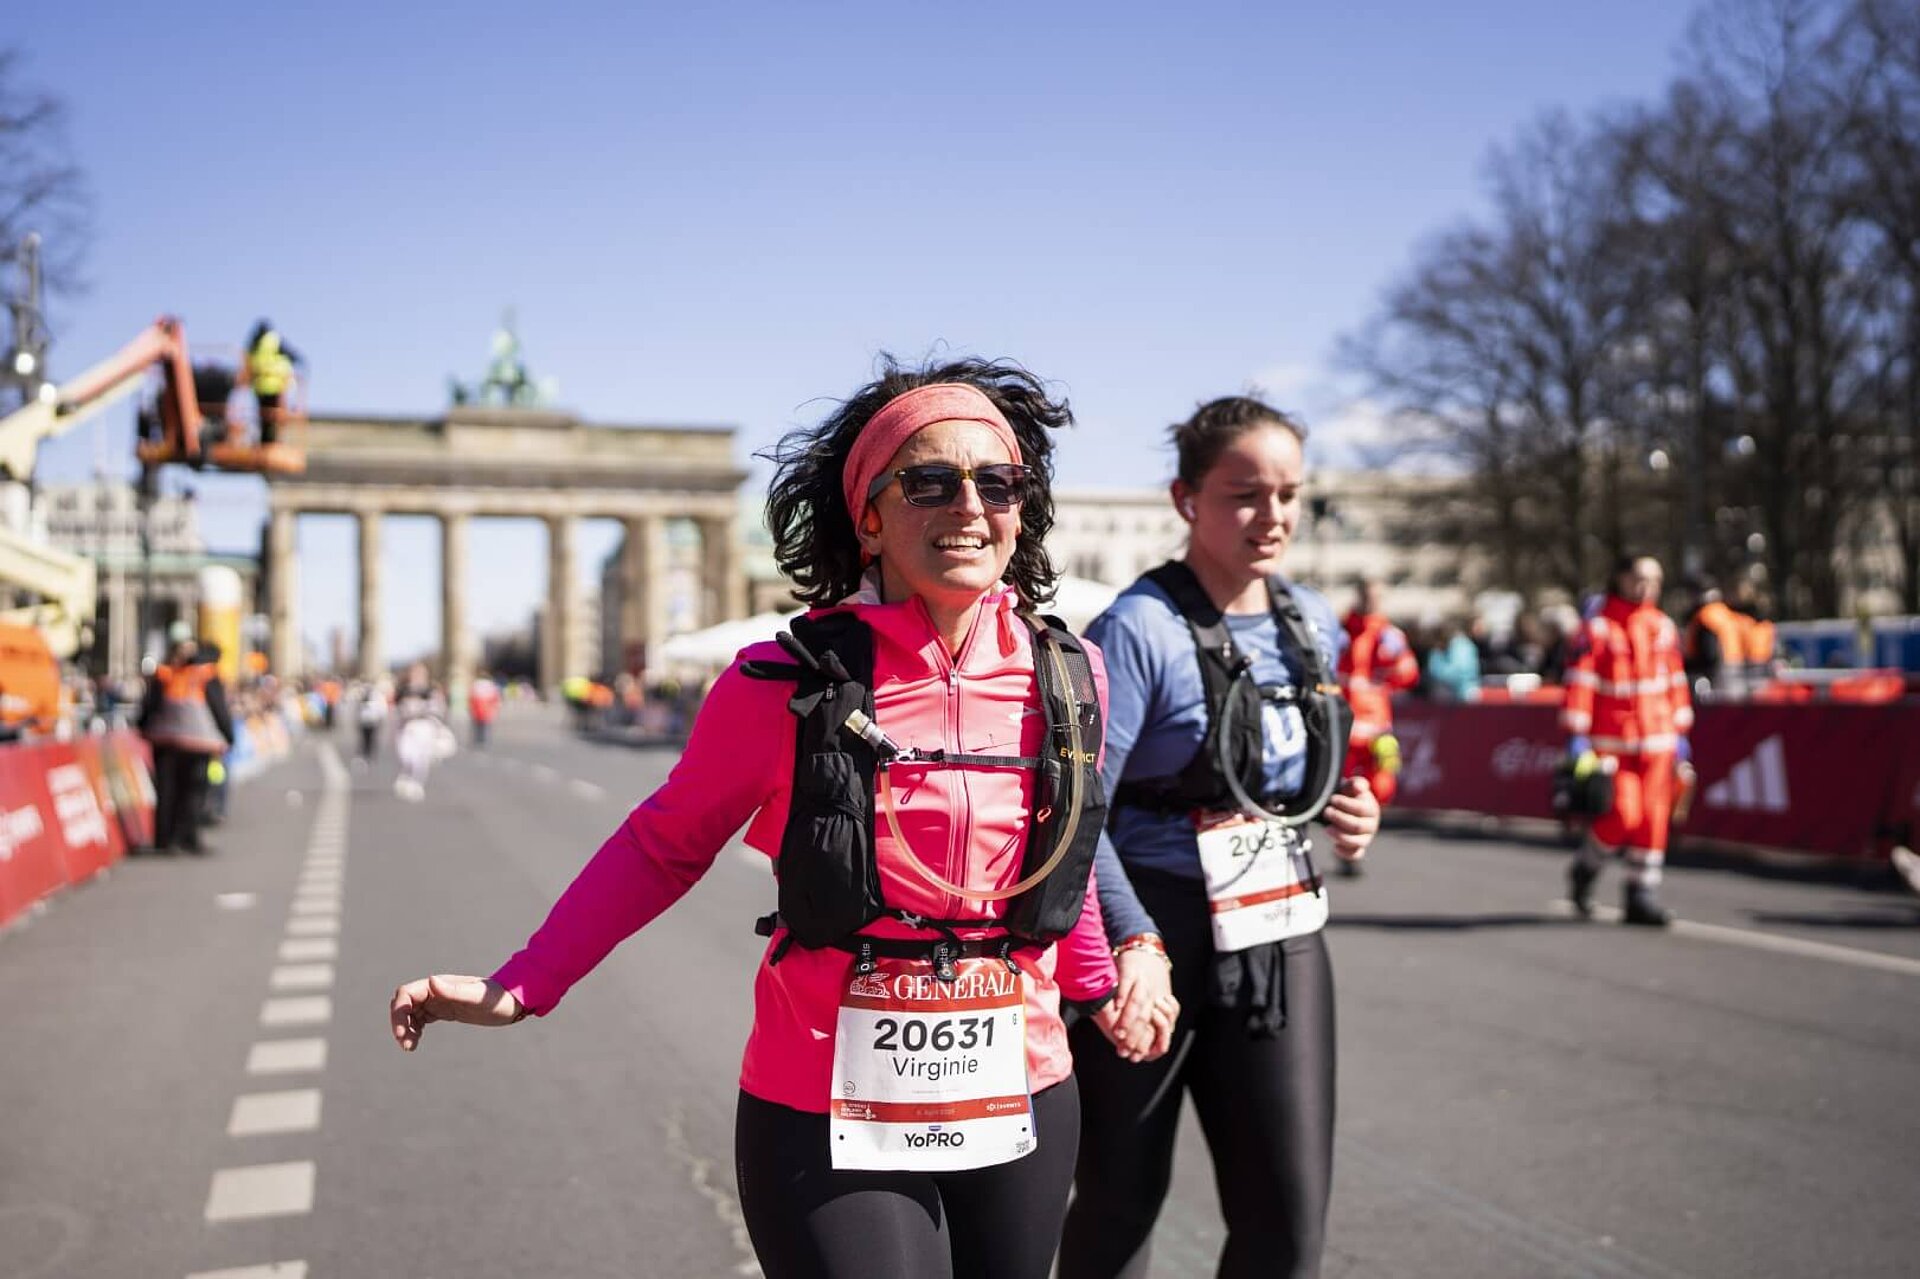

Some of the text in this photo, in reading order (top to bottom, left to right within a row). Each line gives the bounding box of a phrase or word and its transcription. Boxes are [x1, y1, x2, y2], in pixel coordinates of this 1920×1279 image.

[894, 972, 1016, 1001] GENERALI
[873, 1016, 994, 1052] 20631
[893, 1055, 978, 1081] Virginie
[905, 1131, 965, 1148] YoPRO
